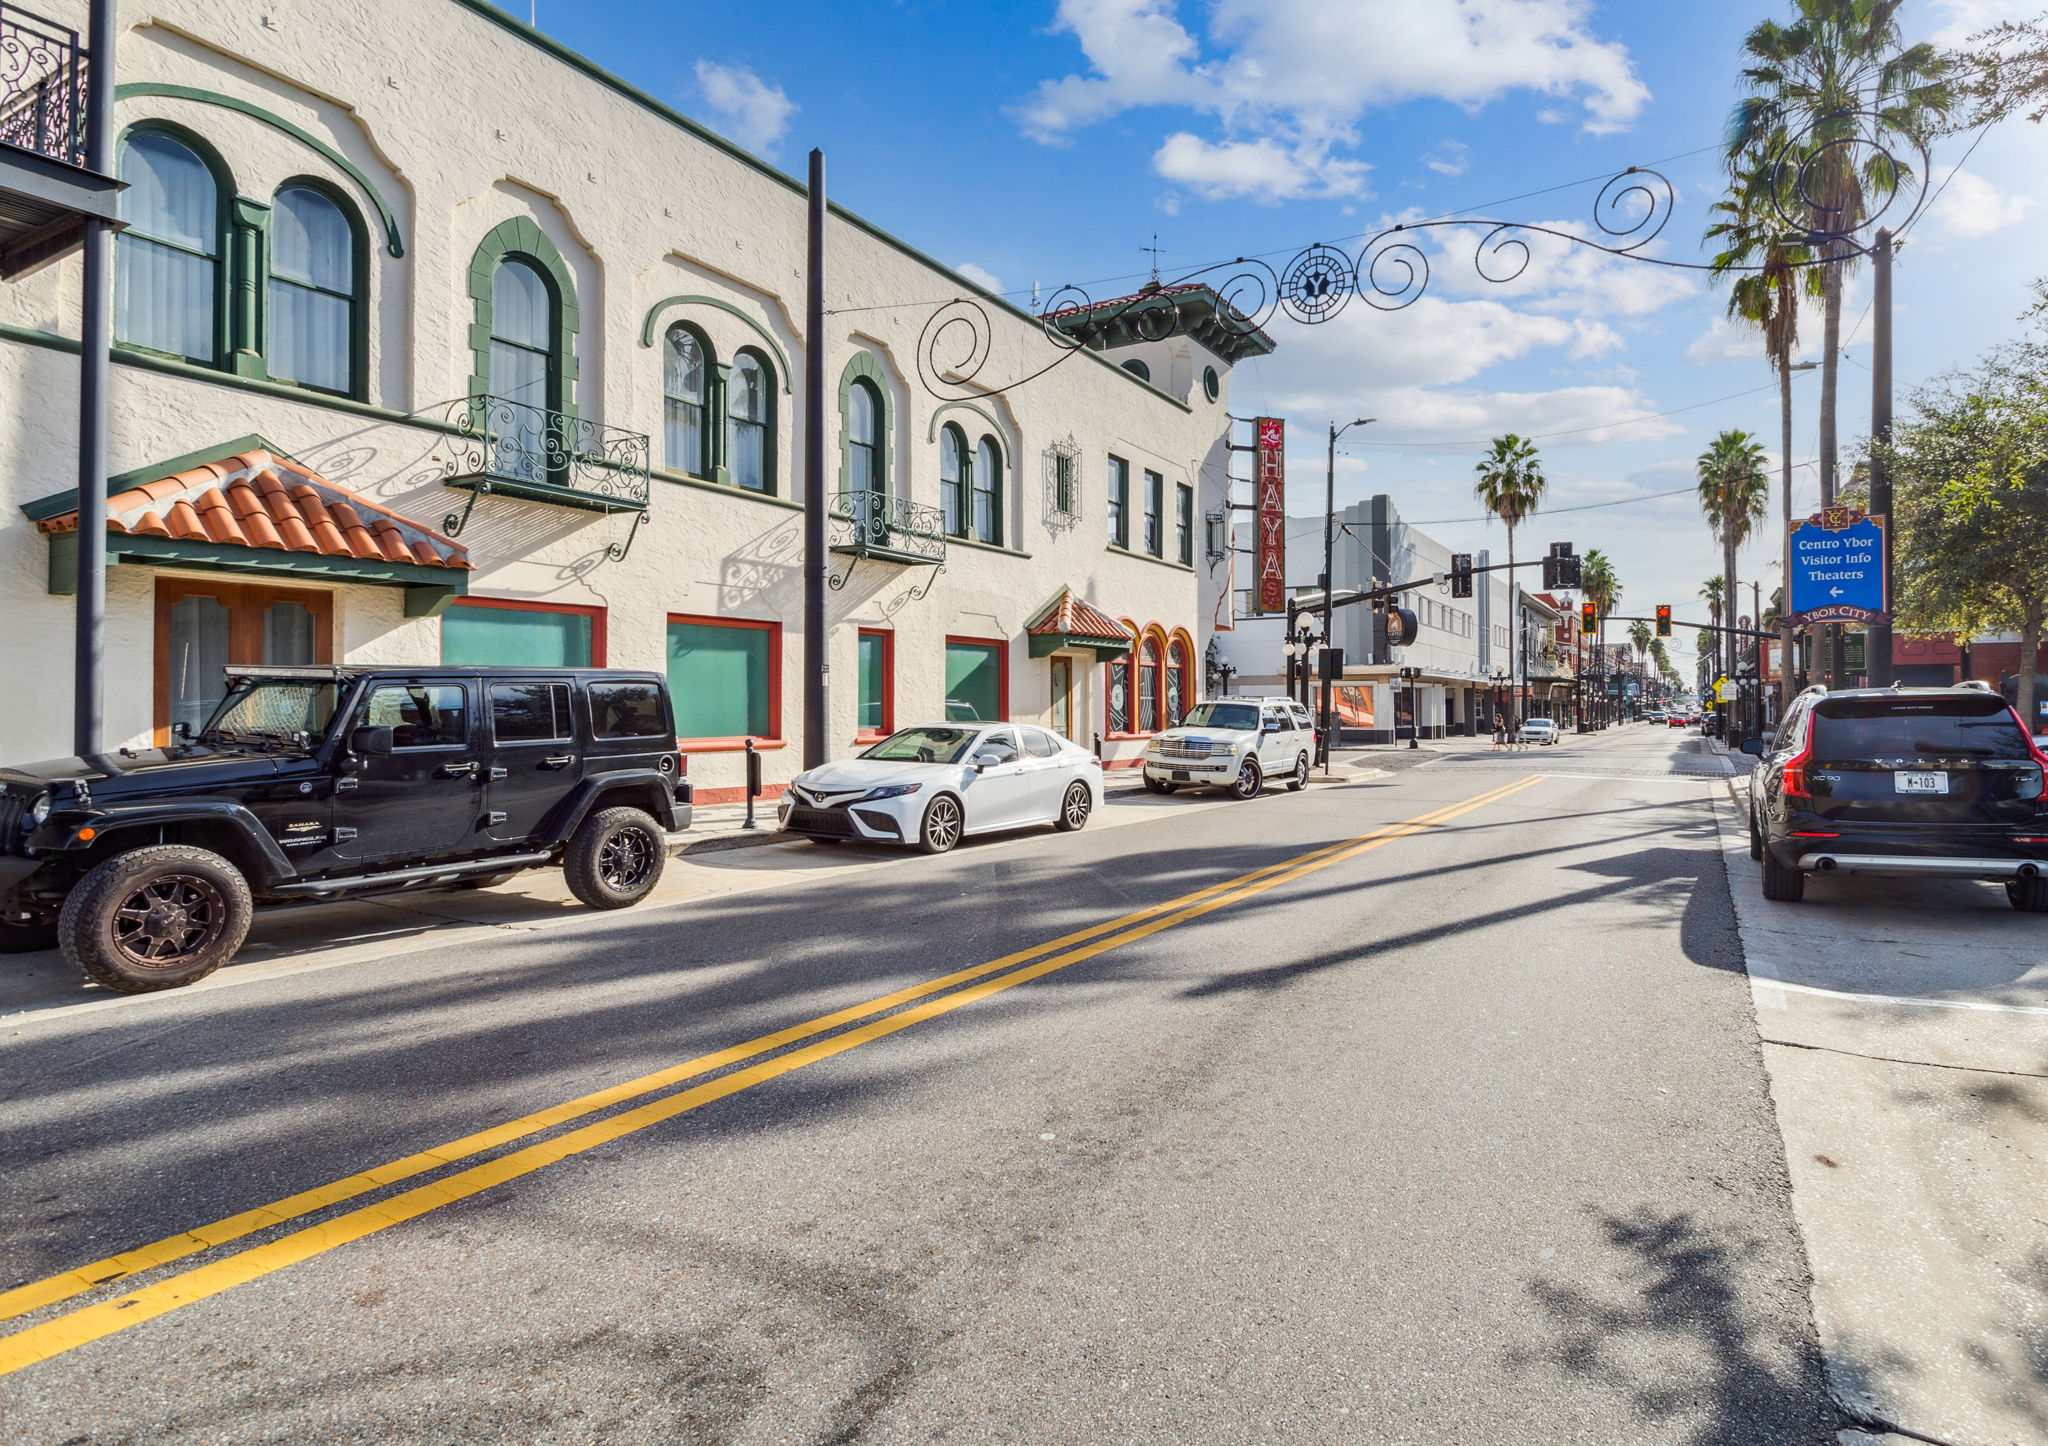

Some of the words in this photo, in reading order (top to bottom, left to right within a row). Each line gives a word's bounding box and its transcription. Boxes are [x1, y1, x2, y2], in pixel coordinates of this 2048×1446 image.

[1261, 450, 1283, 597] HAYAS
[1799, 540, 1840, 550] Centro
[1843, 537, 1874, 548] Ybor
[1801, 554, 1842, 566] Visitor
[1845, 552, 1872, 564] Info
[1808, 570, 1864, 581] Theaters
[1803, 608, 1836, 622] YBOR
[1839, 606, 1871, 620] CITY
[278, 835, 328, 844] WRANGLER
